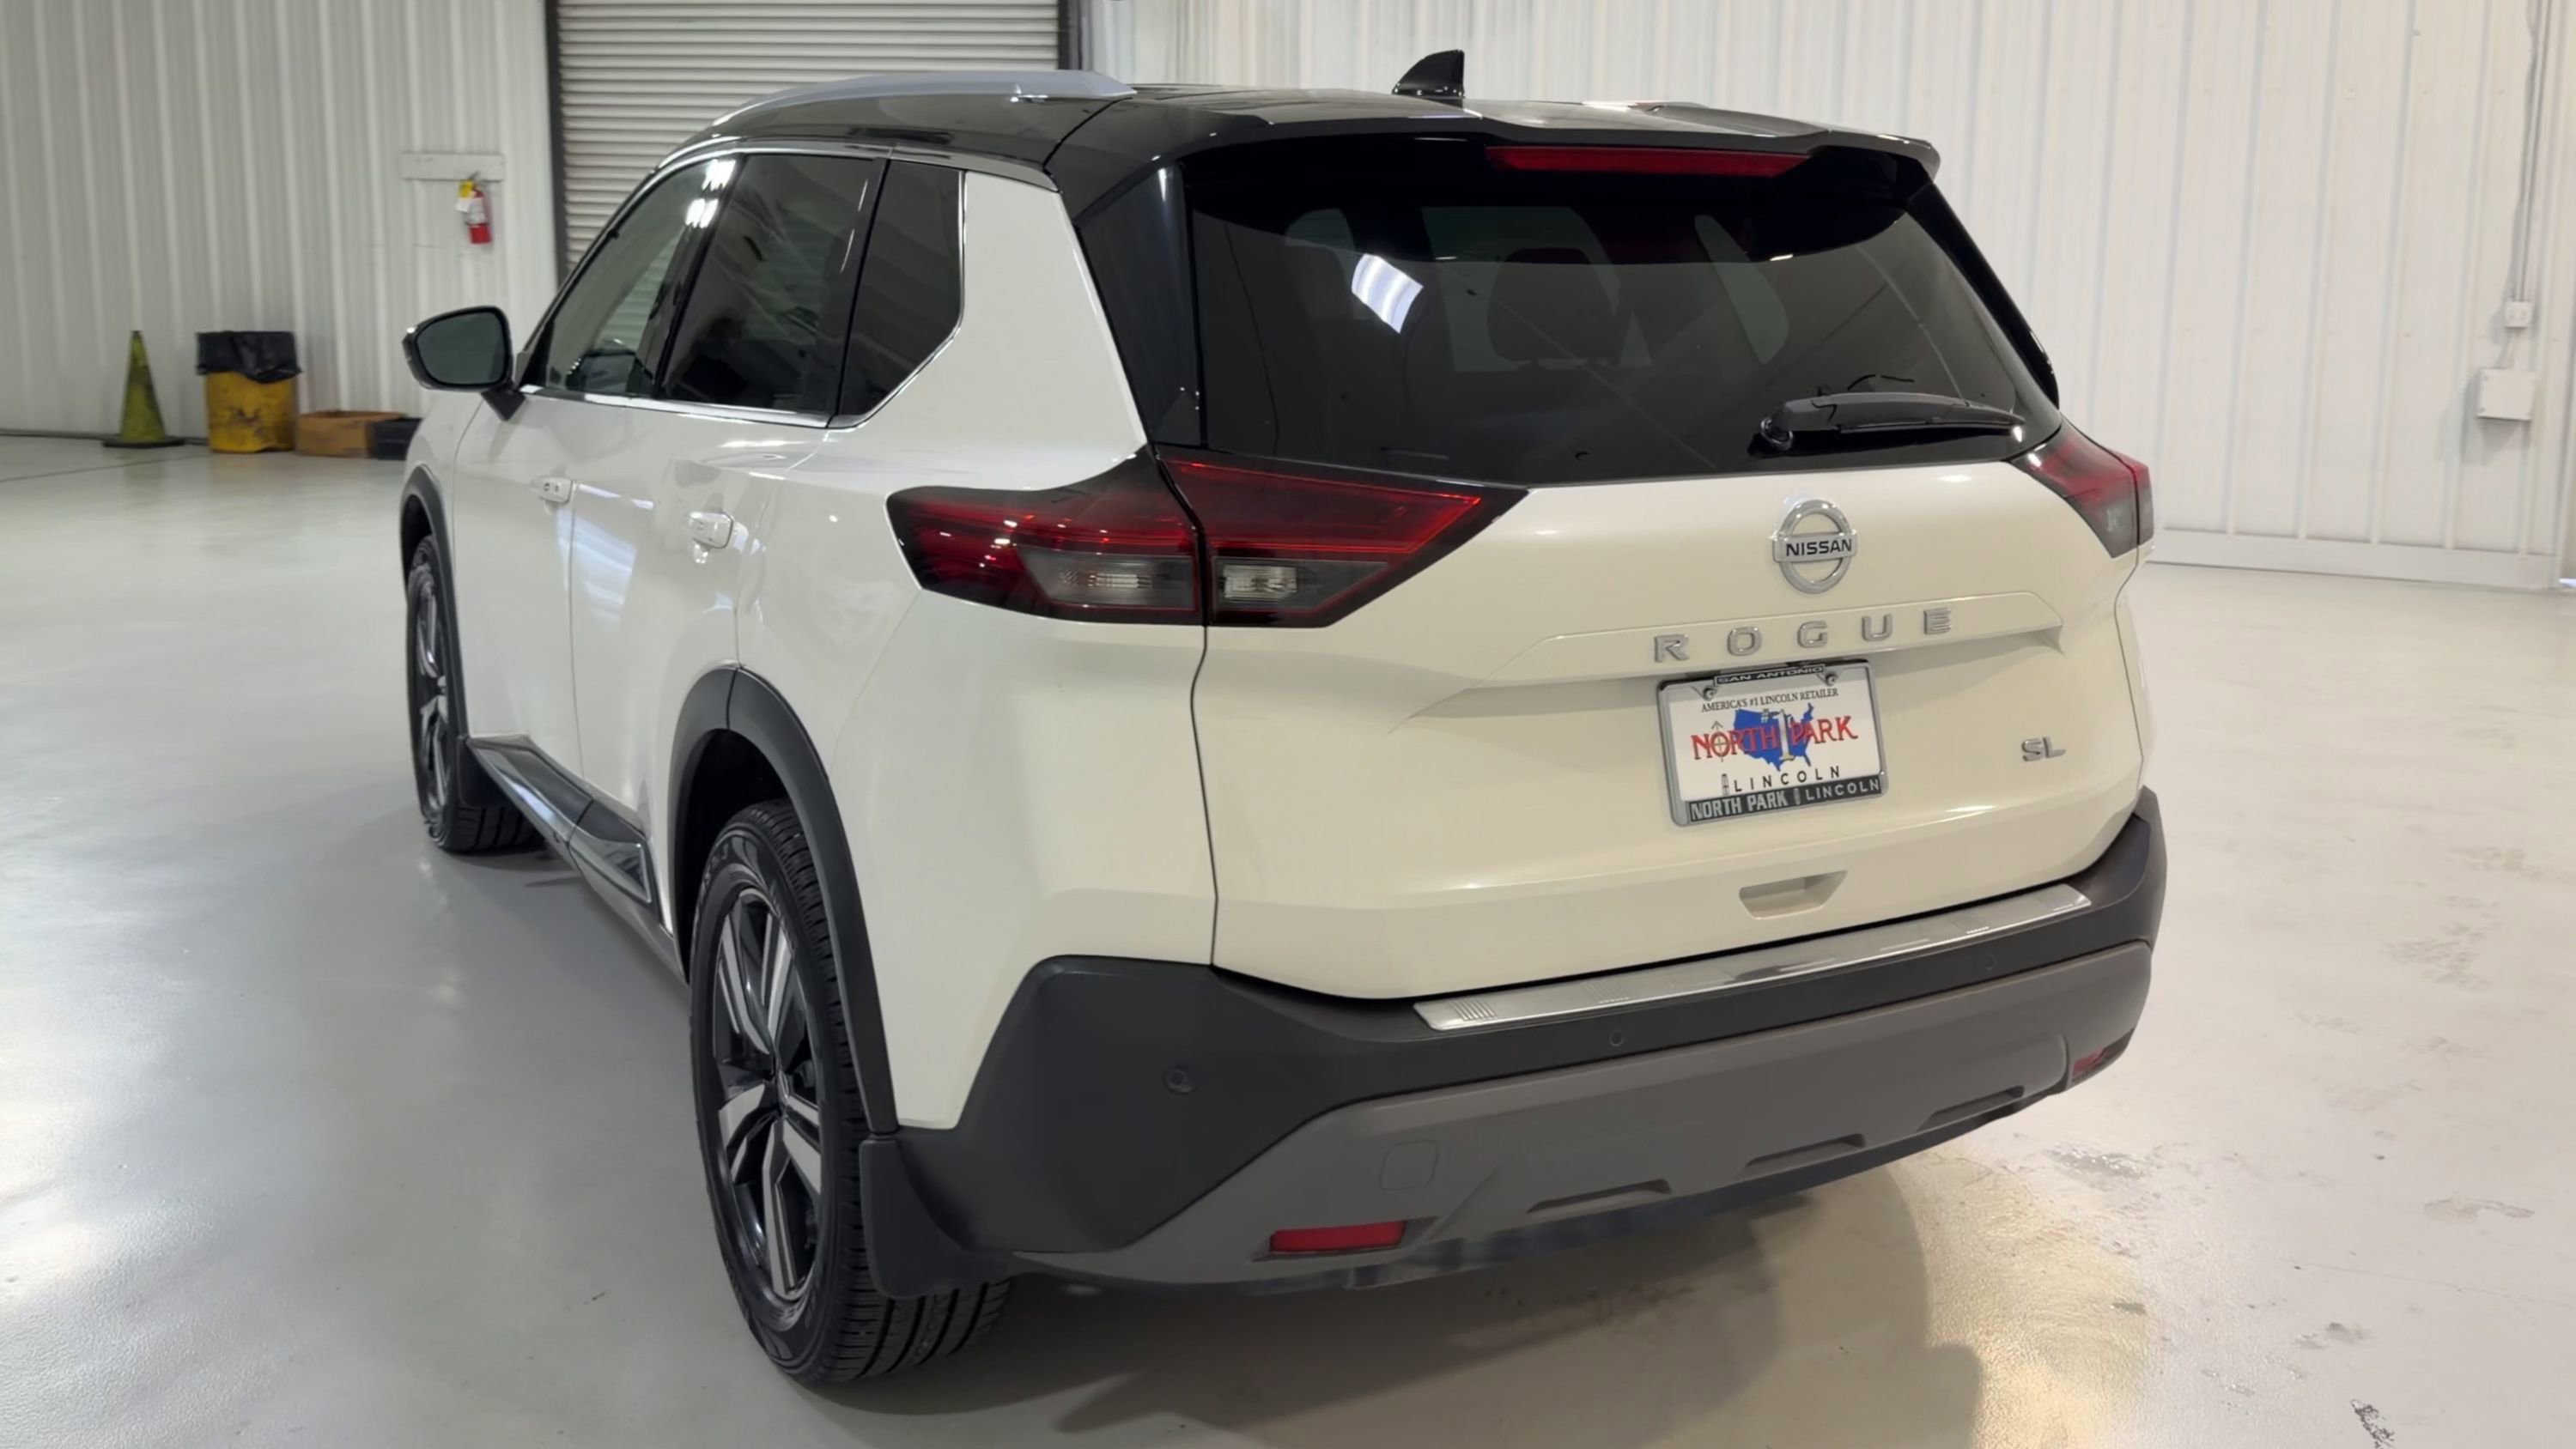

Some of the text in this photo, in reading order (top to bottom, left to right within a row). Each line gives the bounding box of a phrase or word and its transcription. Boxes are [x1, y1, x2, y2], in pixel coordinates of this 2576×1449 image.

[1786, 537, 1853, 557] NISSAN
[1654, 606, 1953, 663] ROGUE
[1716, 666, 1824, 684] SAN ANTONIO
[1701, 698, 1747, 712] AMERICA'S
[1759, 693, 1798, 706] LINCOLN
[1800, 688, 1839, 700] RETAILER
[1690, 715, 1859, 761] NORTH PARK
[2021, 736, 2066, 762] SL
[1734, 765, 1840, 792] LINCOLN
[1691, 779, 1880, 822] NORTH PARK LINCOLN
